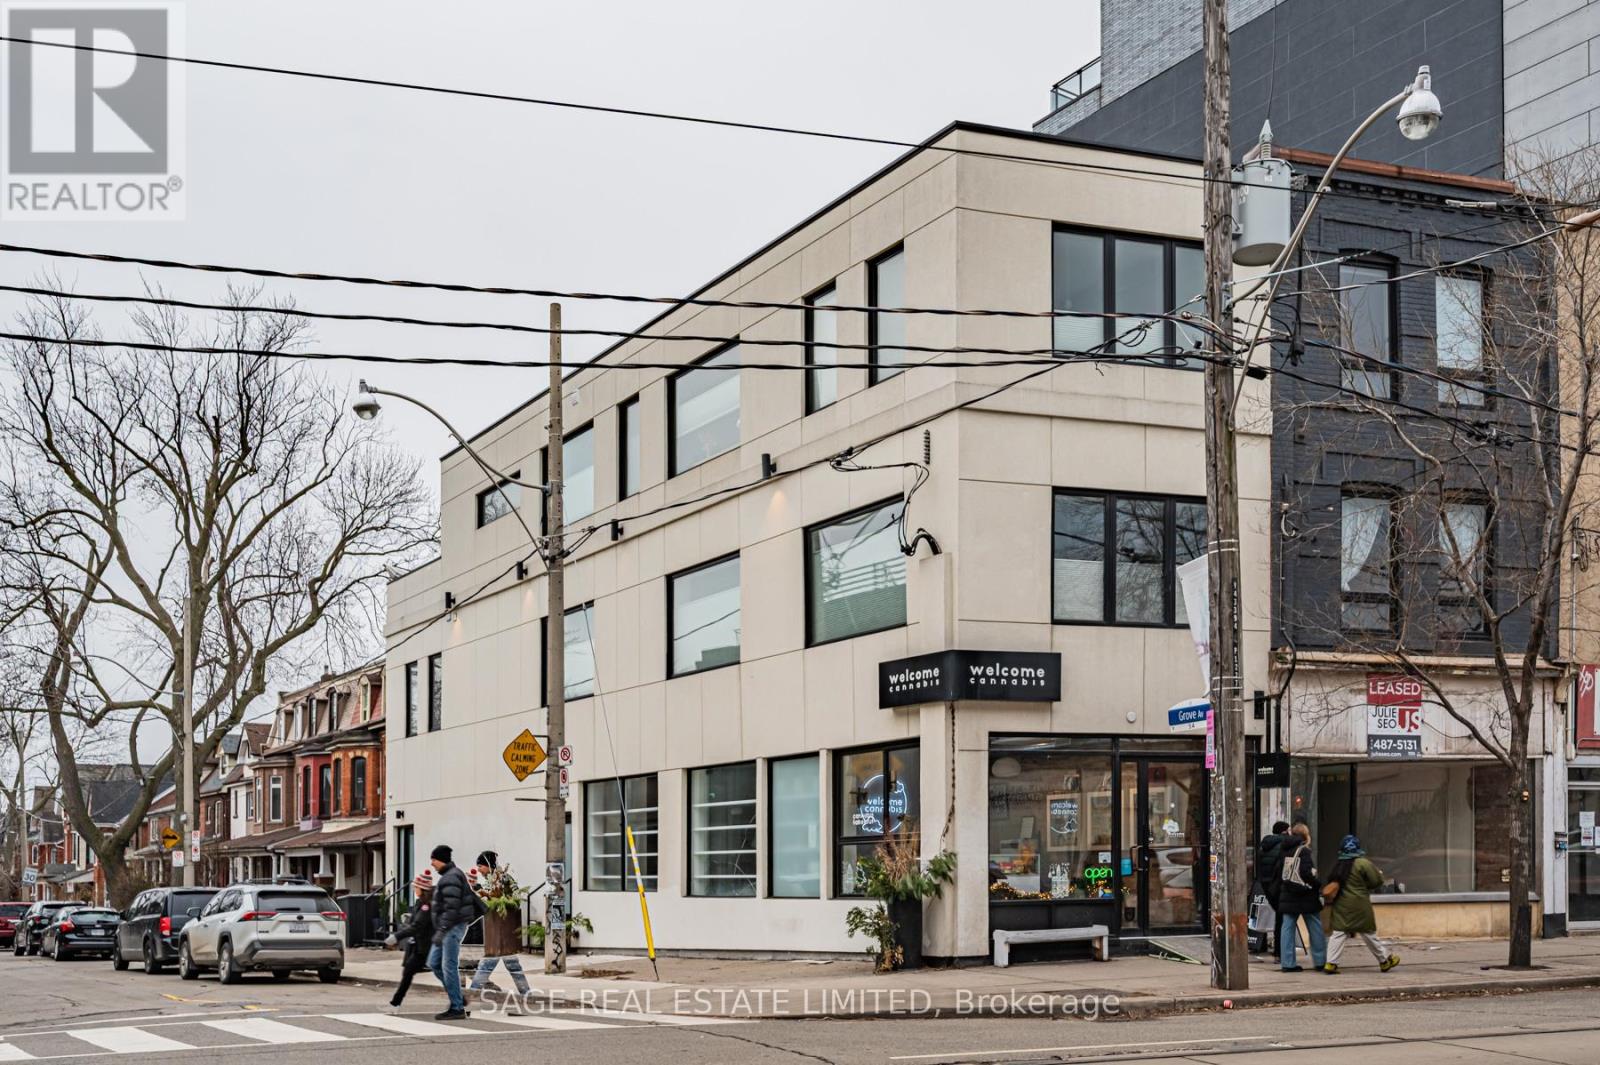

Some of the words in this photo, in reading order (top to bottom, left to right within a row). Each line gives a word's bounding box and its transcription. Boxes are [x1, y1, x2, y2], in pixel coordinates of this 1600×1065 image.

[889, 667, 940, 684] welcome
[970, 663, 1045, 677] welcome
[889, 679, 940, 692] cannabis
[970, 677, 1045, 686] cannabis
[1369, 682, 1421, 695] LEASED
[1178, 710, 1197, 721] Grove
[1372, 706, 1397, 718] JULIE
[1378, 718, 1397, 729] SEO
[513, 742, 537, 752] TRAFFIC
[1373, 739, 1417, 750] 487-5131
[511, 753, 536, 763] CALMING
[515, 765, 529, 774] ZONE
[24, 872, 36, 881] 30
[1084, 867, 1113, 884] open
